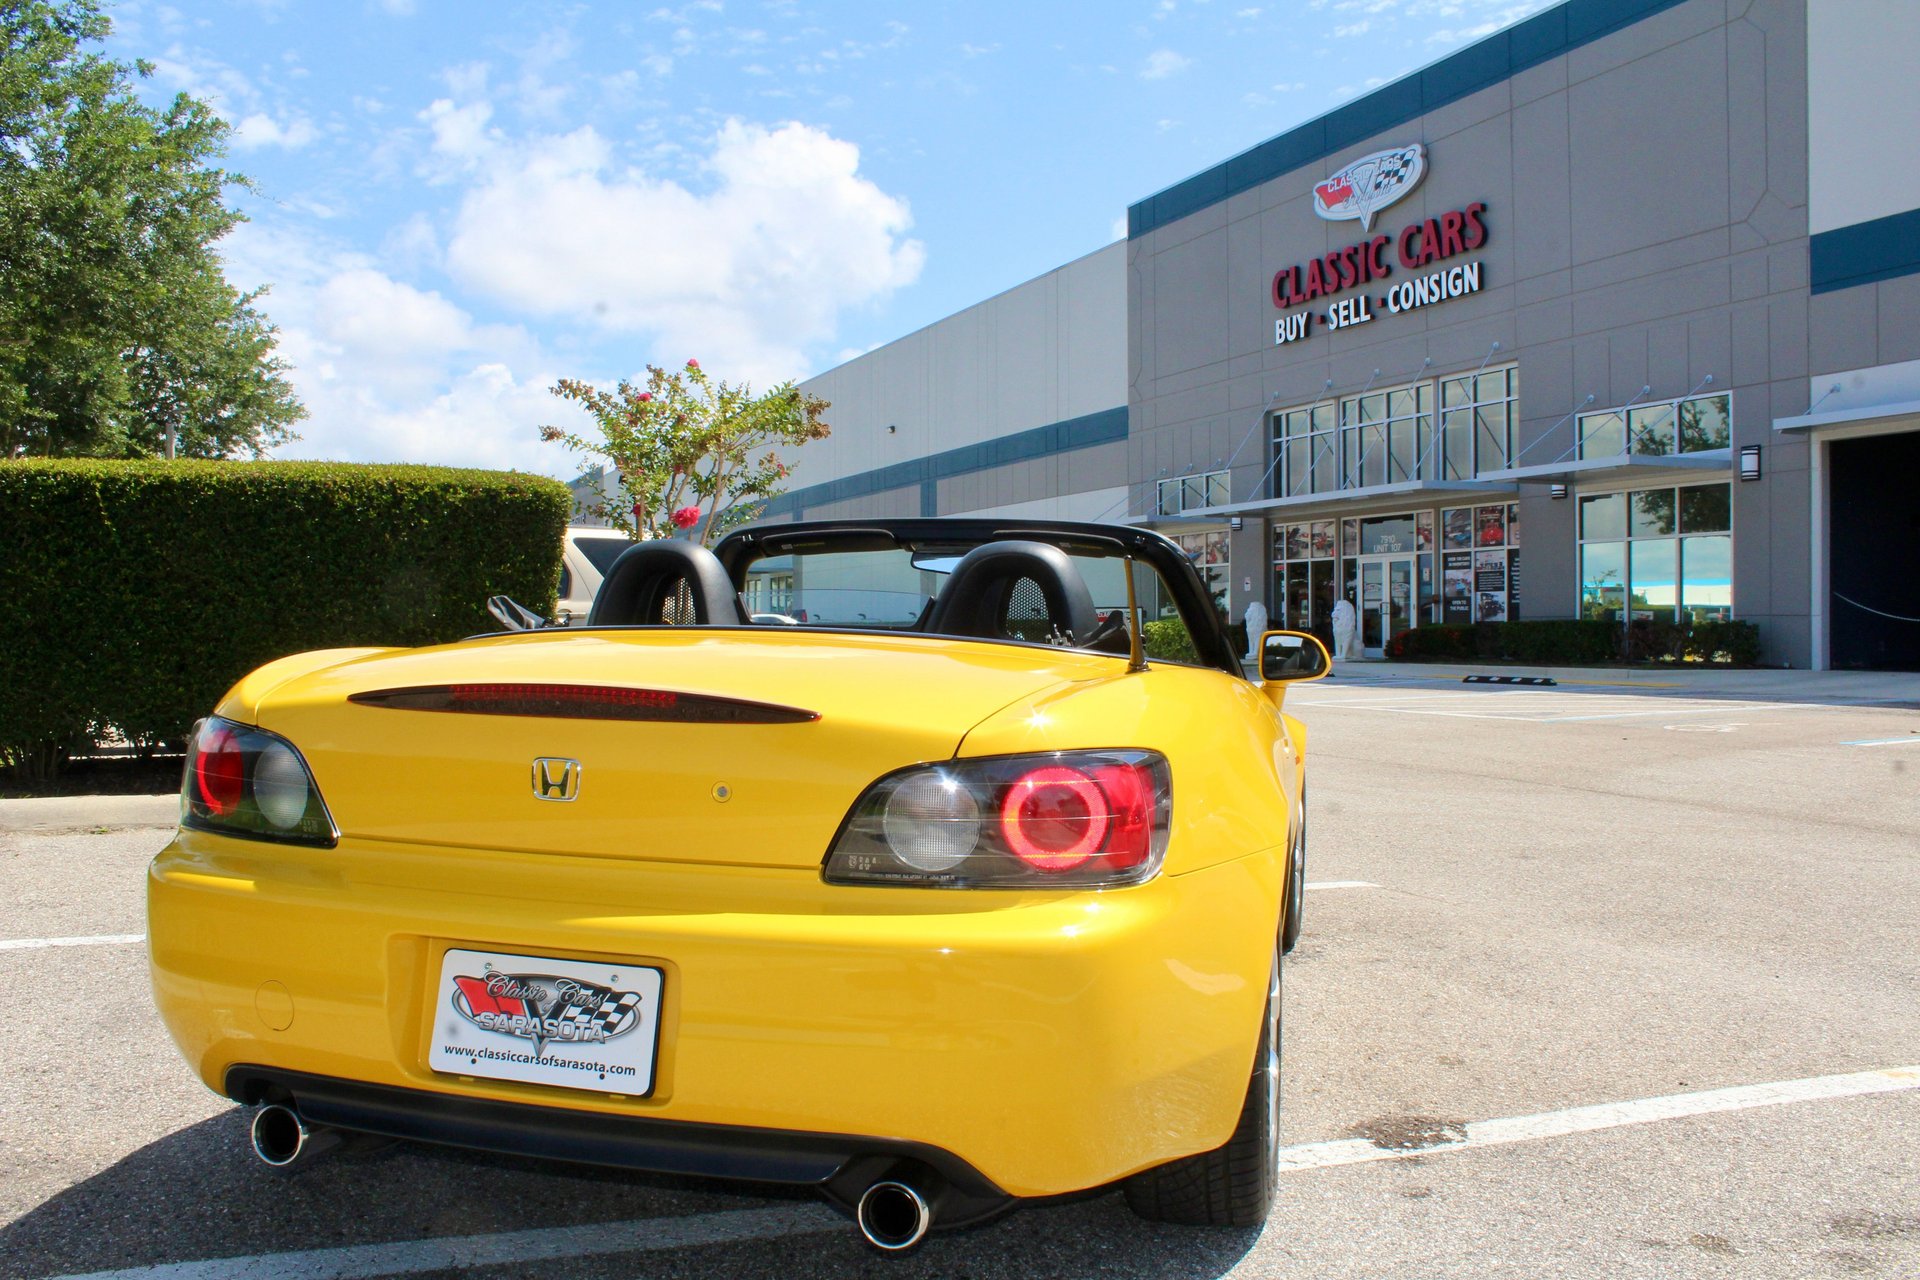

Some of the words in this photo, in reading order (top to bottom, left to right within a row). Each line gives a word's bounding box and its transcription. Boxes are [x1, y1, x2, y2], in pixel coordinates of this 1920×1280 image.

[1272, 235, 1391, 309] CLASSIC
[1398, 202, 1486, 269] CARS
[1275, 311, 1309, 345] BUY
[1328, 295, 1371, 331] SELL
[1388, 261, 1480, 314] CONSIGN
[1373, 544, 1388, 552] UNIT
[484, 971, 548, 1001] Classic
[555, 979, 605, 1008] Cars
[478, 1011, 606, 1044] SARASOTA
[444, 1045, 636, 1076] www.classiccarsofsarasota.com
